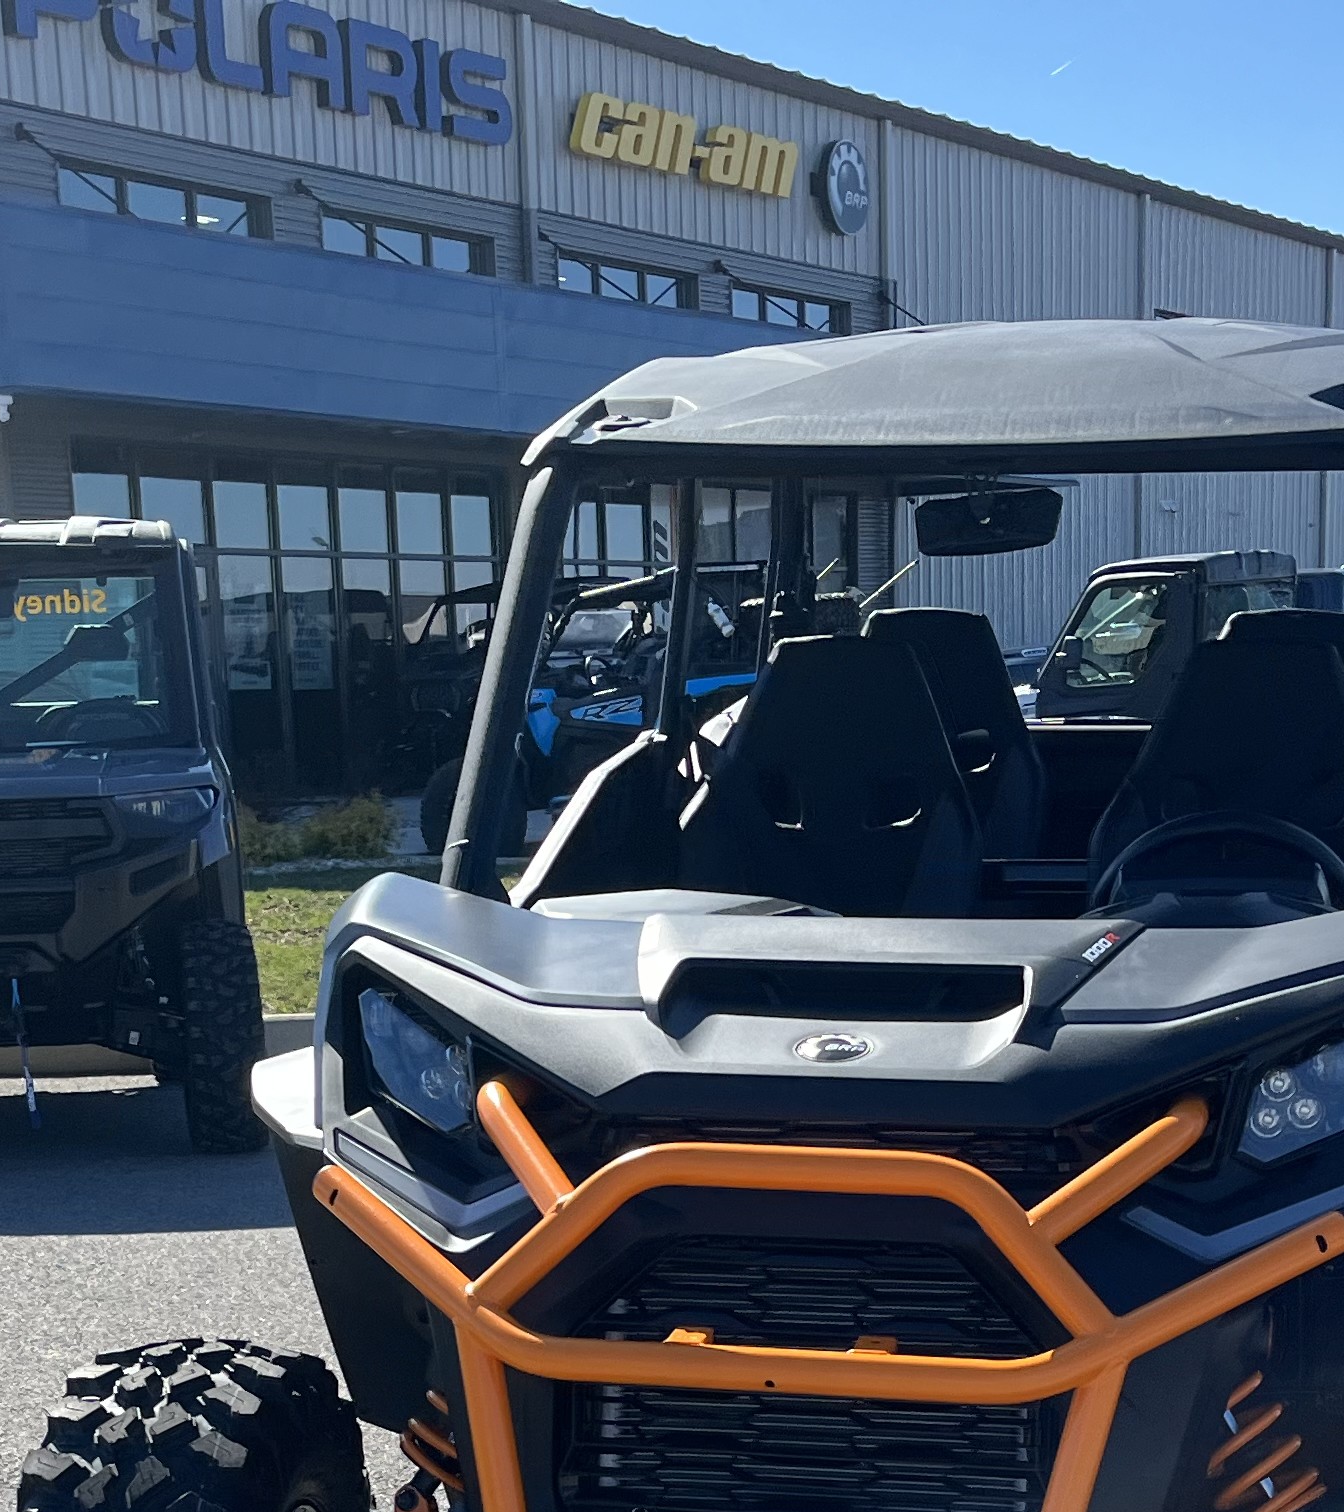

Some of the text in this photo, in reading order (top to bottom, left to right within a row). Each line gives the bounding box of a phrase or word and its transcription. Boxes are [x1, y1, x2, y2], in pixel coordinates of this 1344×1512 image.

[570, 92, 799, 198] can-am
[845, 190, 869, 208] BRP
[581, 697, 642, 719] RZ
[1081, 932, 1120, 962] 1000R
